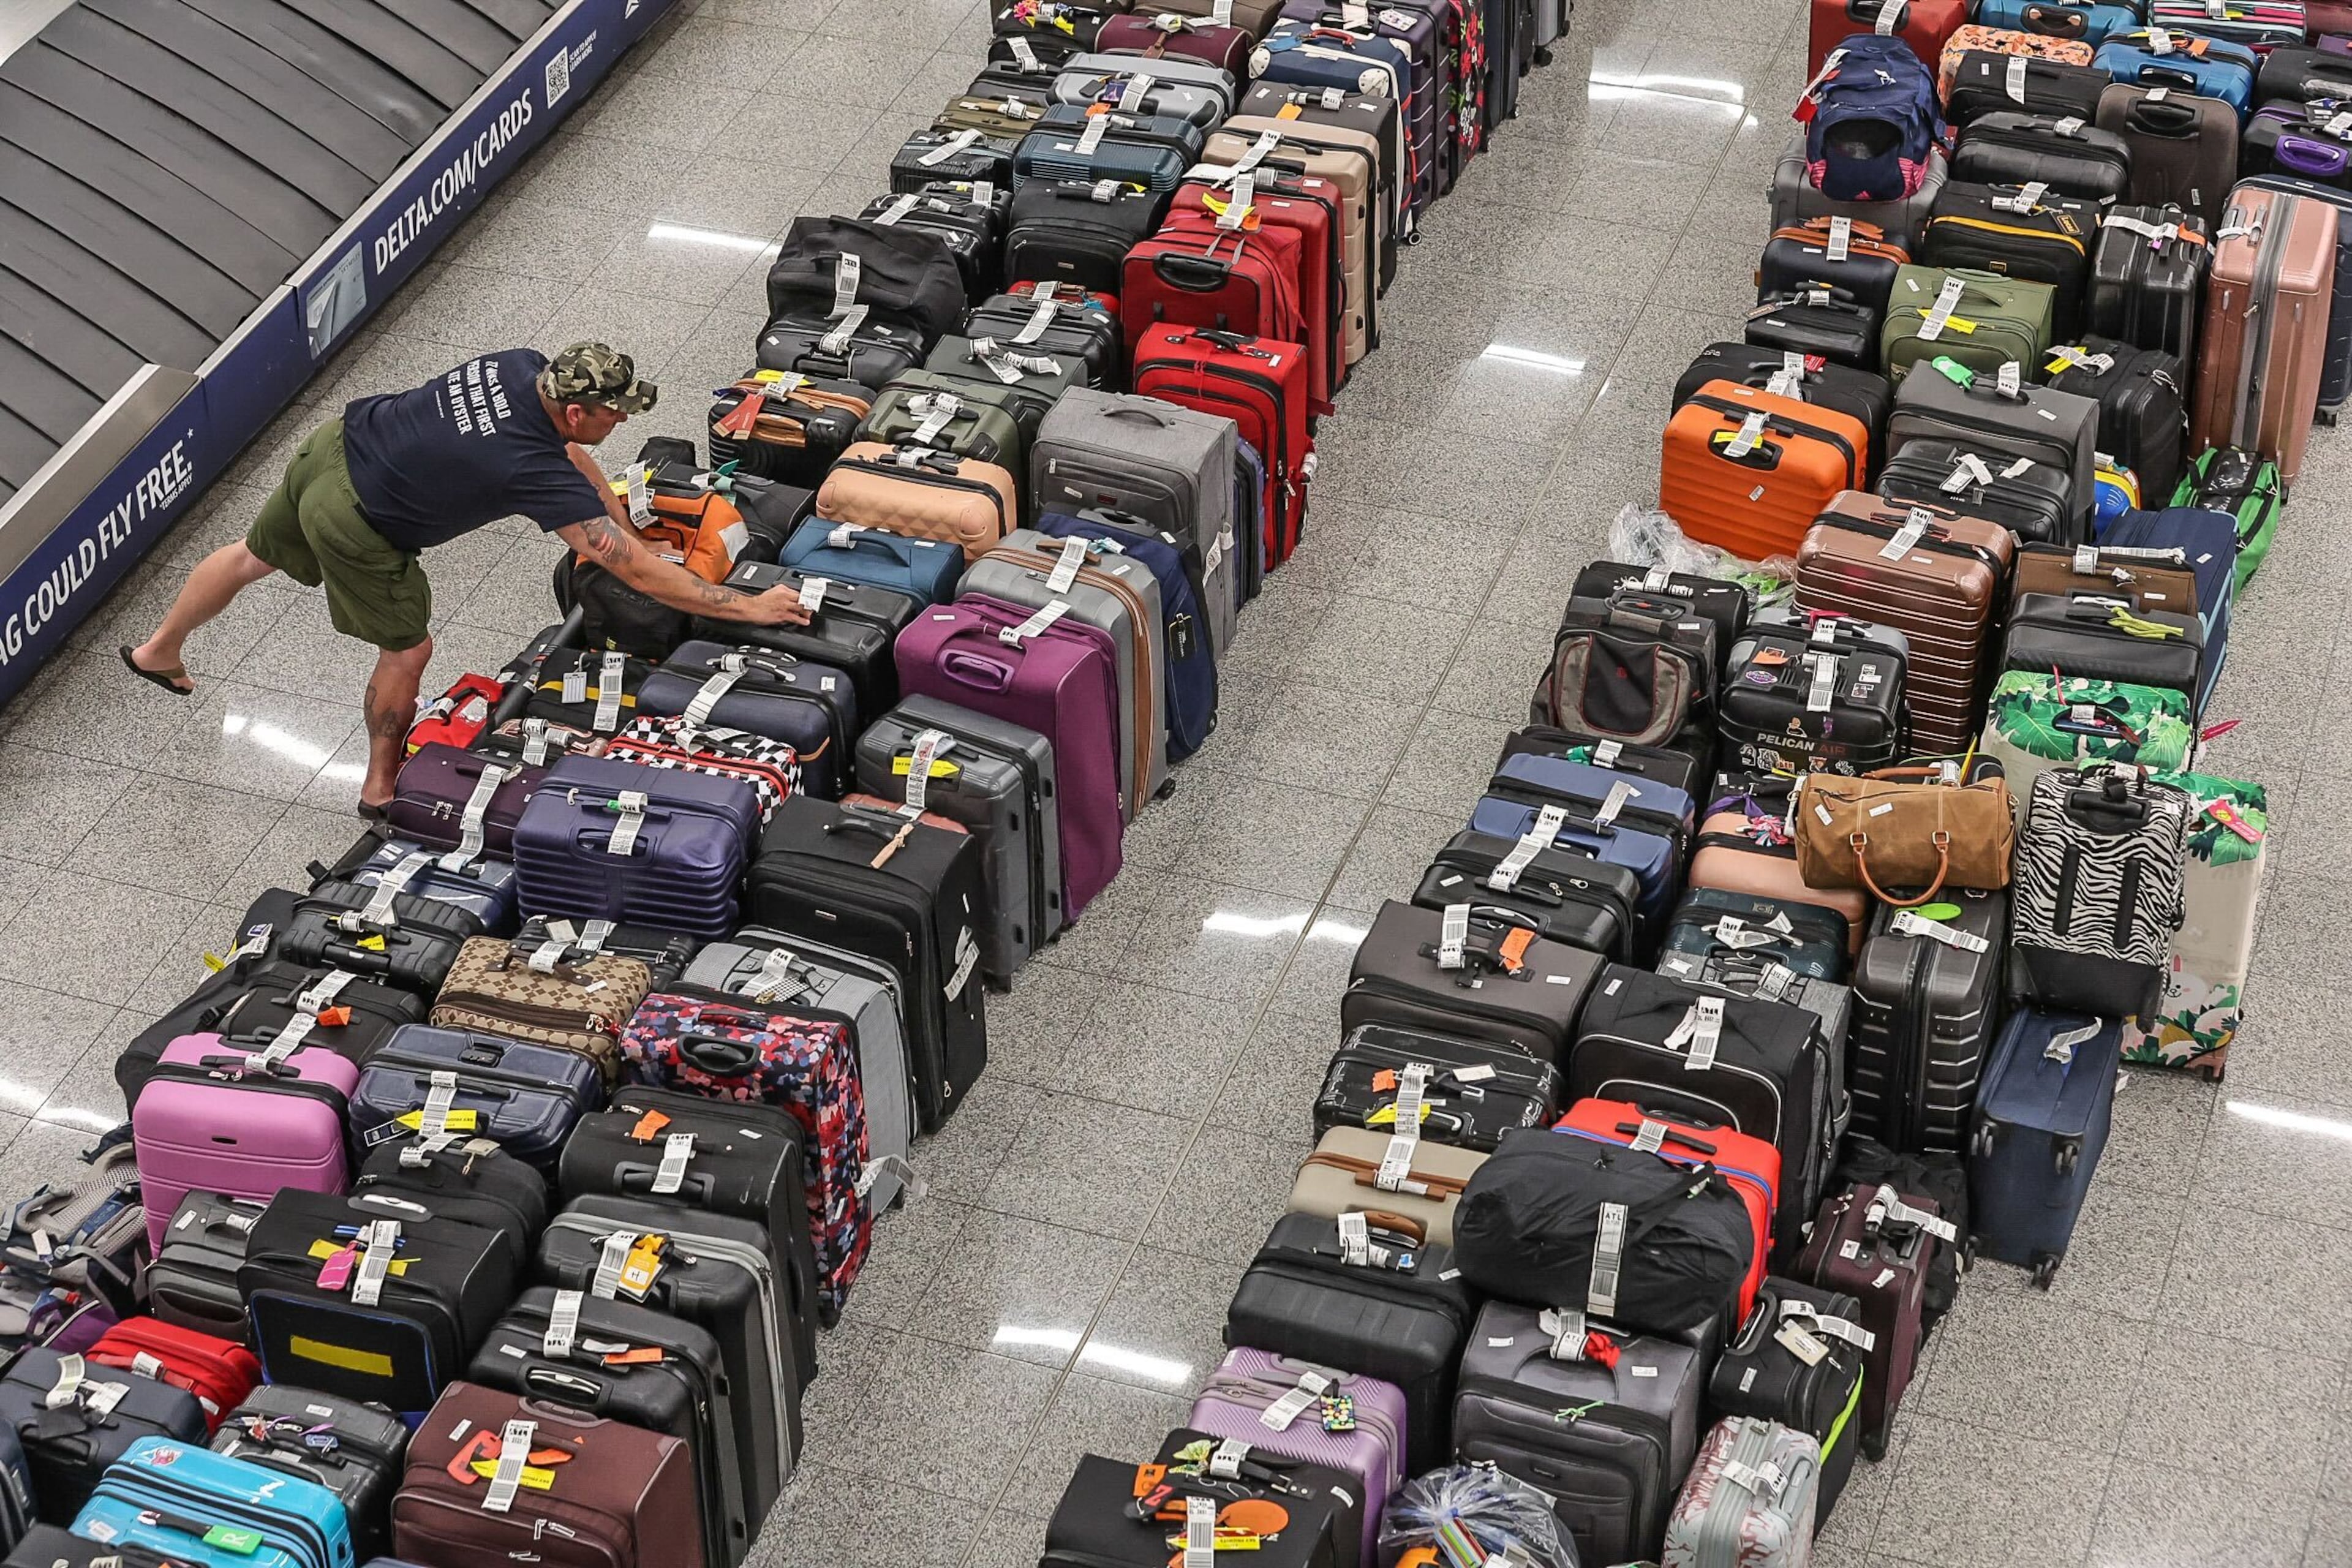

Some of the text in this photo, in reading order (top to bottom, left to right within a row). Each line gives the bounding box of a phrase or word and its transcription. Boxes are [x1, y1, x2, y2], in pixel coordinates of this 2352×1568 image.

[374, 88, 532, 276] DELTA.COM/CARDS
[469, 384, 486, 408] THAT
[490, 384, 502, 396] A
[447, 370, 473, 435] ATE AN OYSTER
[492, 391, 512, 420] BOLD
[474, 407, 497, 437] FIRST
[178, 472, 193, 495] APPLY
[24, 537, 96, 636] COULD
[98, 492, 132, 561] FLY
[1757, 733, 1847, 755] PELICAN AIR
[1605, 1213, 1622, 1221] ATL
[1564, 1333, 1581, 1343] ATL
[221, 1532, 251, 1548] R
